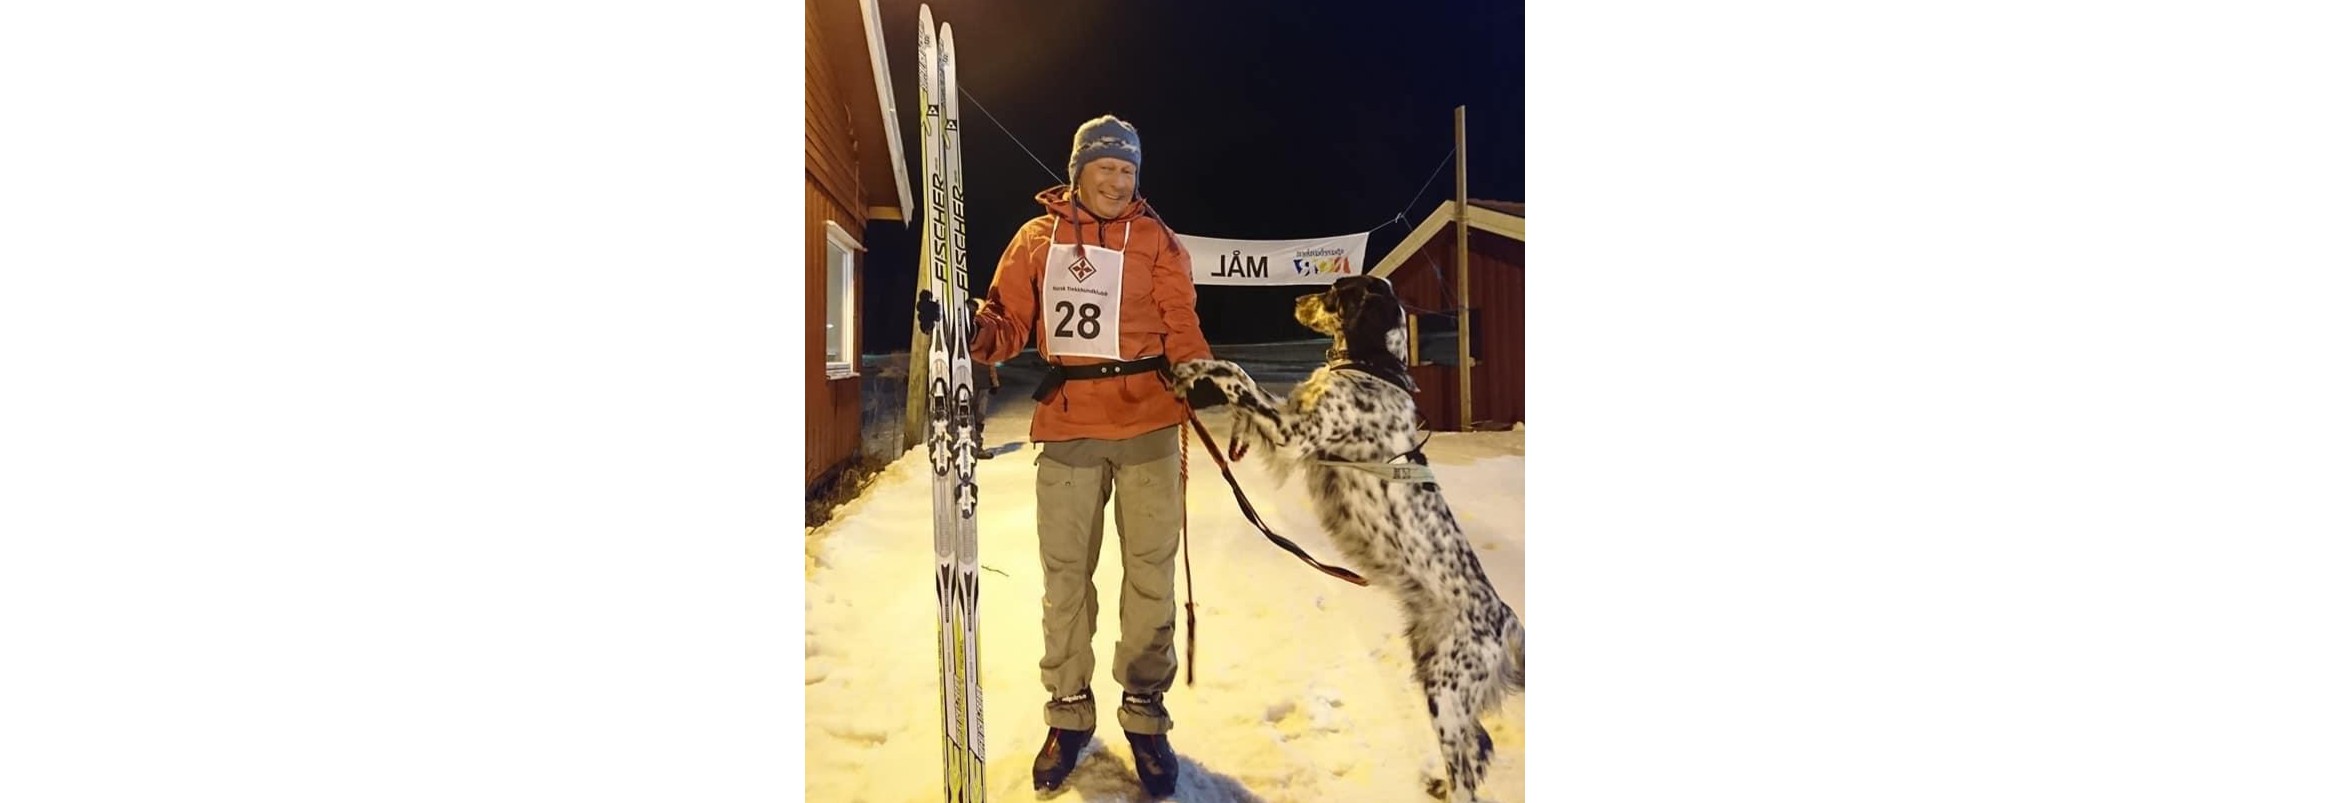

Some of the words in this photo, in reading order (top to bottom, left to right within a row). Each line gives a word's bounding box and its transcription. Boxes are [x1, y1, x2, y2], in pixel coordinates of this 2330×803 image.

[933, 173, 948, 283] FISCHER
[952, 185, 969, 293] FISCHER
[1054, 301, 1101, 339] 28
